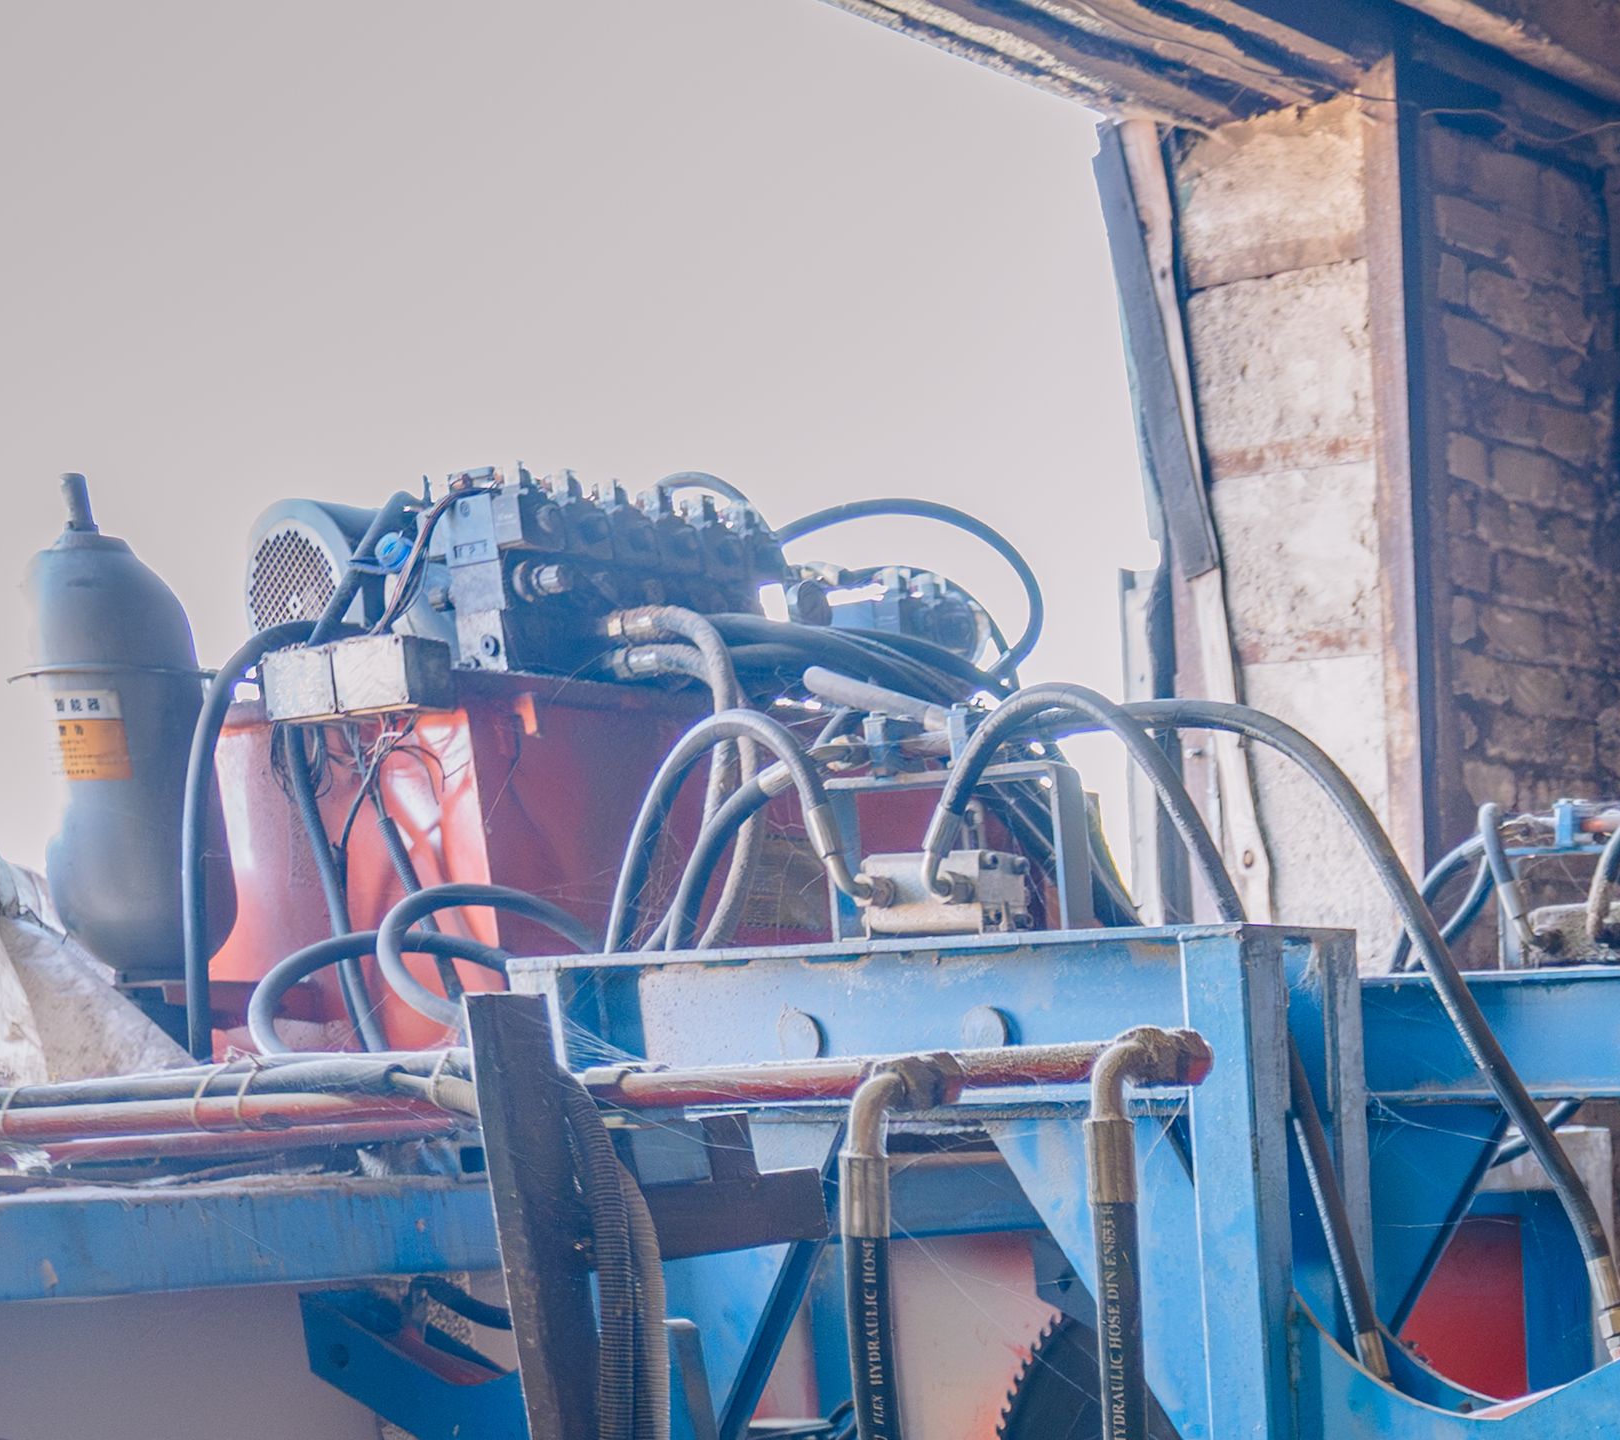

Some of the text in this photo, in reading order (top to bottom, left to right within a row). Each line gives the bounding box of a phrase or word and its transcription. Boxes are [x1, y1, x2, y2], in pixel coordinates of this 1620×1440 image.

[1105, 1271, 1119, 1299] DIN
[864, 1289, 883, 1385] HYDRAULIC
[1107, 1305, 1122, 1348] HOSE
[873, 1395, 884, 1424] FLEX
